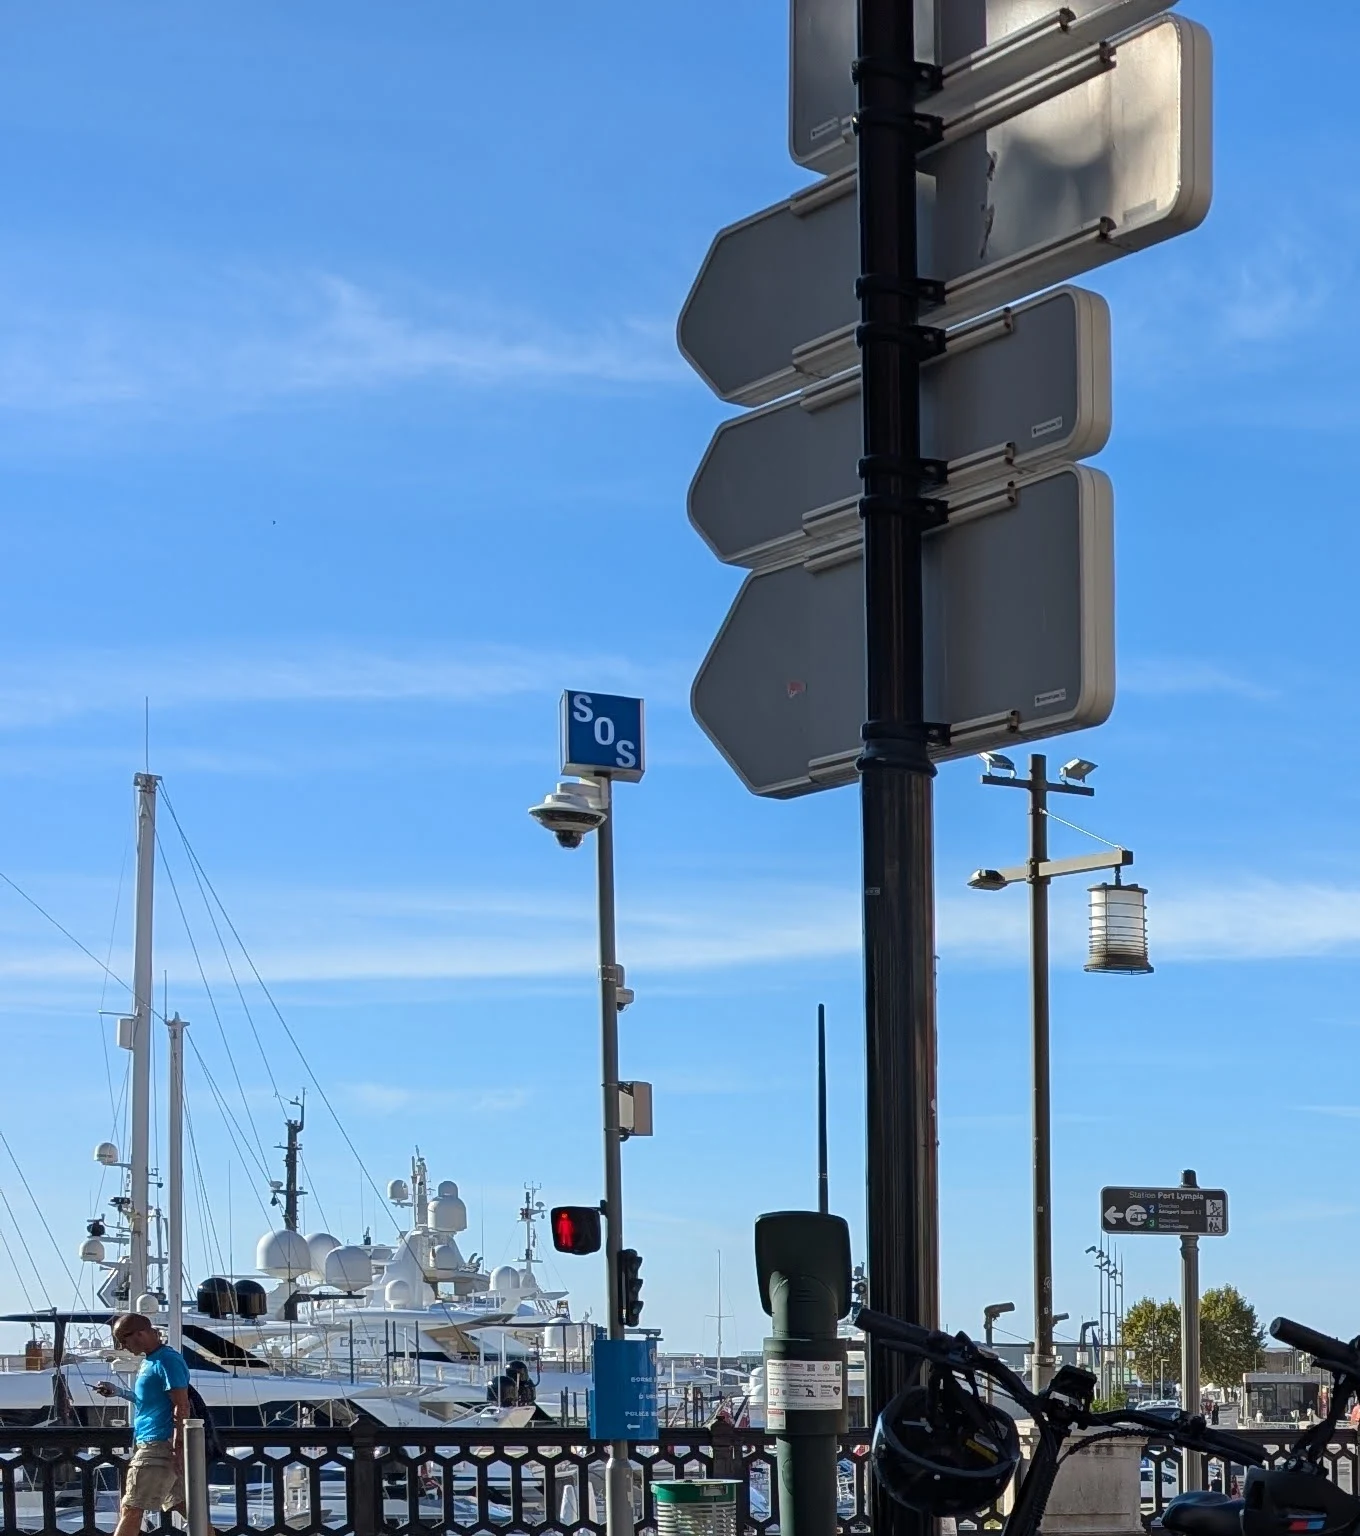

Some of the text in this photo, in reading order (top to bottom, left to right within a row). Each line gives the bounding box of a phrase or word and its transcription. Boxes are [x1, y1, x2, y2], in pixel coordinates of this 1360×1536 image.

[573, 693, 636, 768] SOS
[1129, 1191, 1156, 1199] Station
[1176, 1192, 1204, 1201] Lympia
[1149, 1205, 1155, 1214] 2
